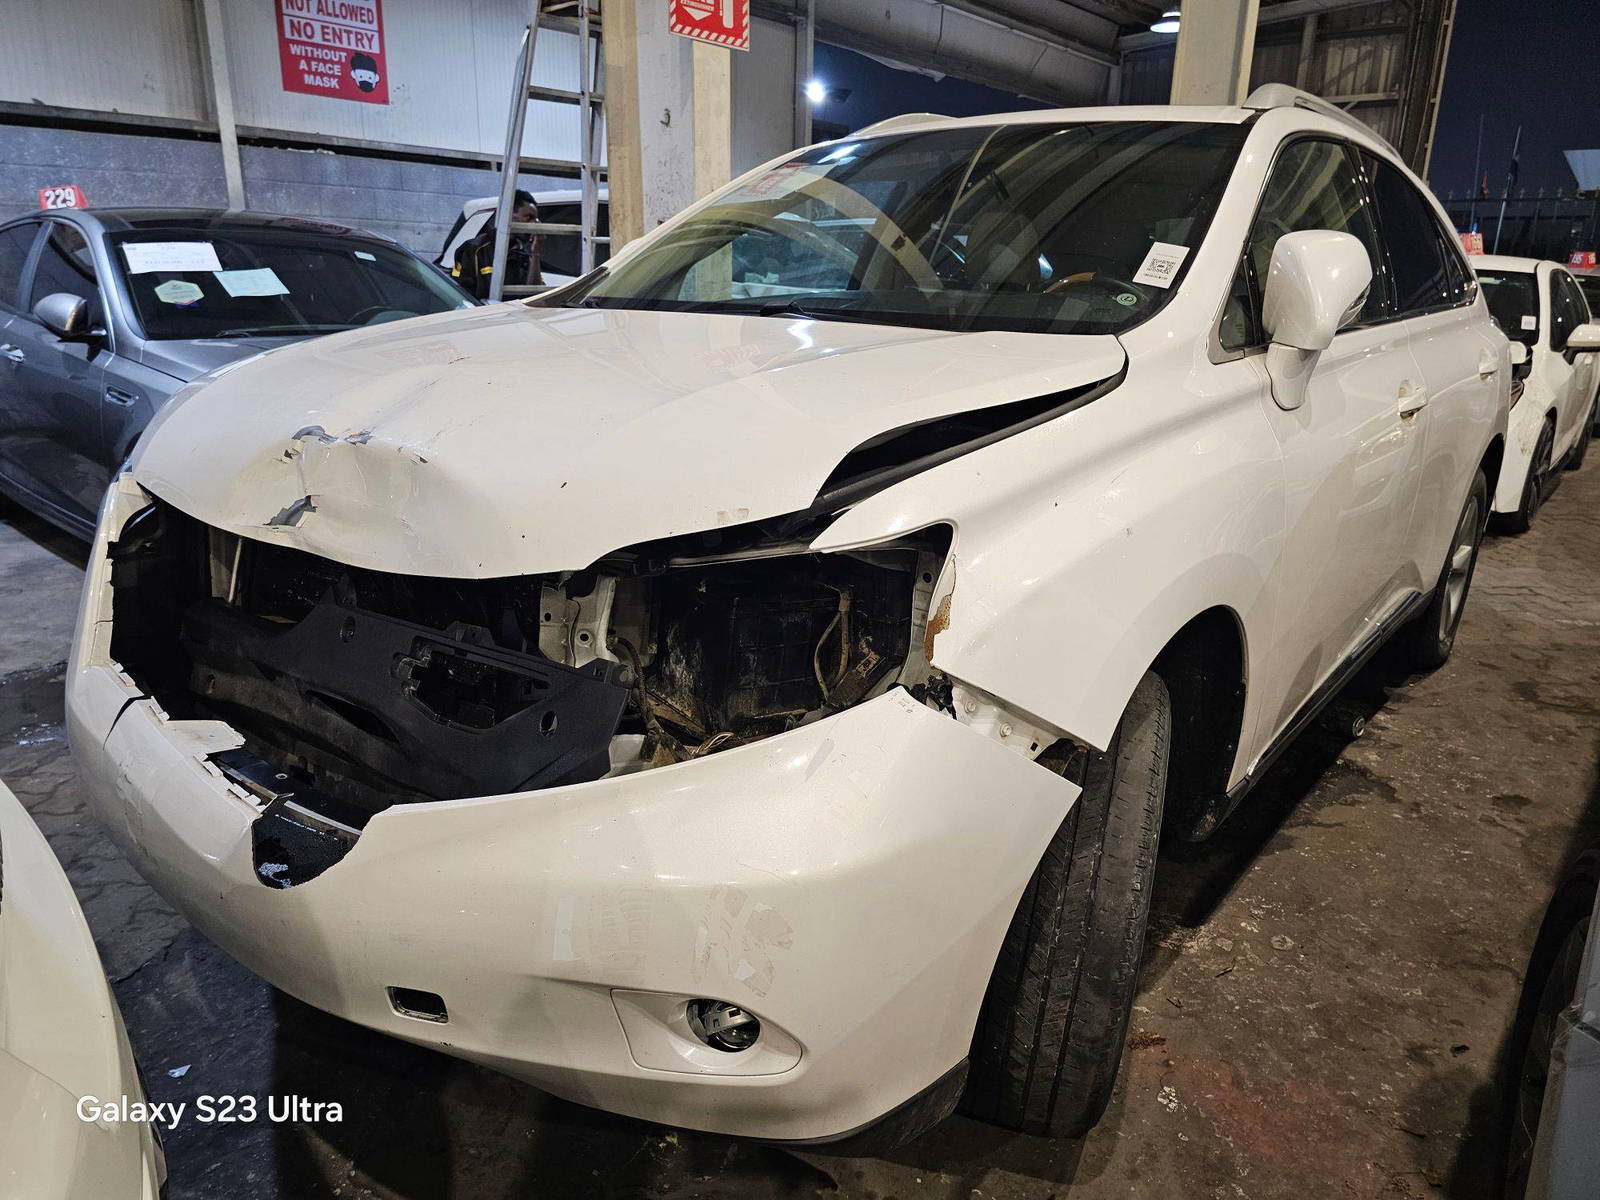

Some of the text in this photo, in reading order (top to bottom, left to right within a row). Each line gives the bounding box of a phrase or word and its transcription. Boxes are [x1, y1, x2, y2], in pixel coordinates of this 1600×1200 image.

[285, 0, 375, 25] NOT ALLOWED
[289, 19, 375, 50] NO ENTRY
[288, 43, 347, 63] WITHOUT
[299, 60, 342, 76] A FACE
[304, 74, 340, 89] MASK
[44, 187, 76, 209] 229
